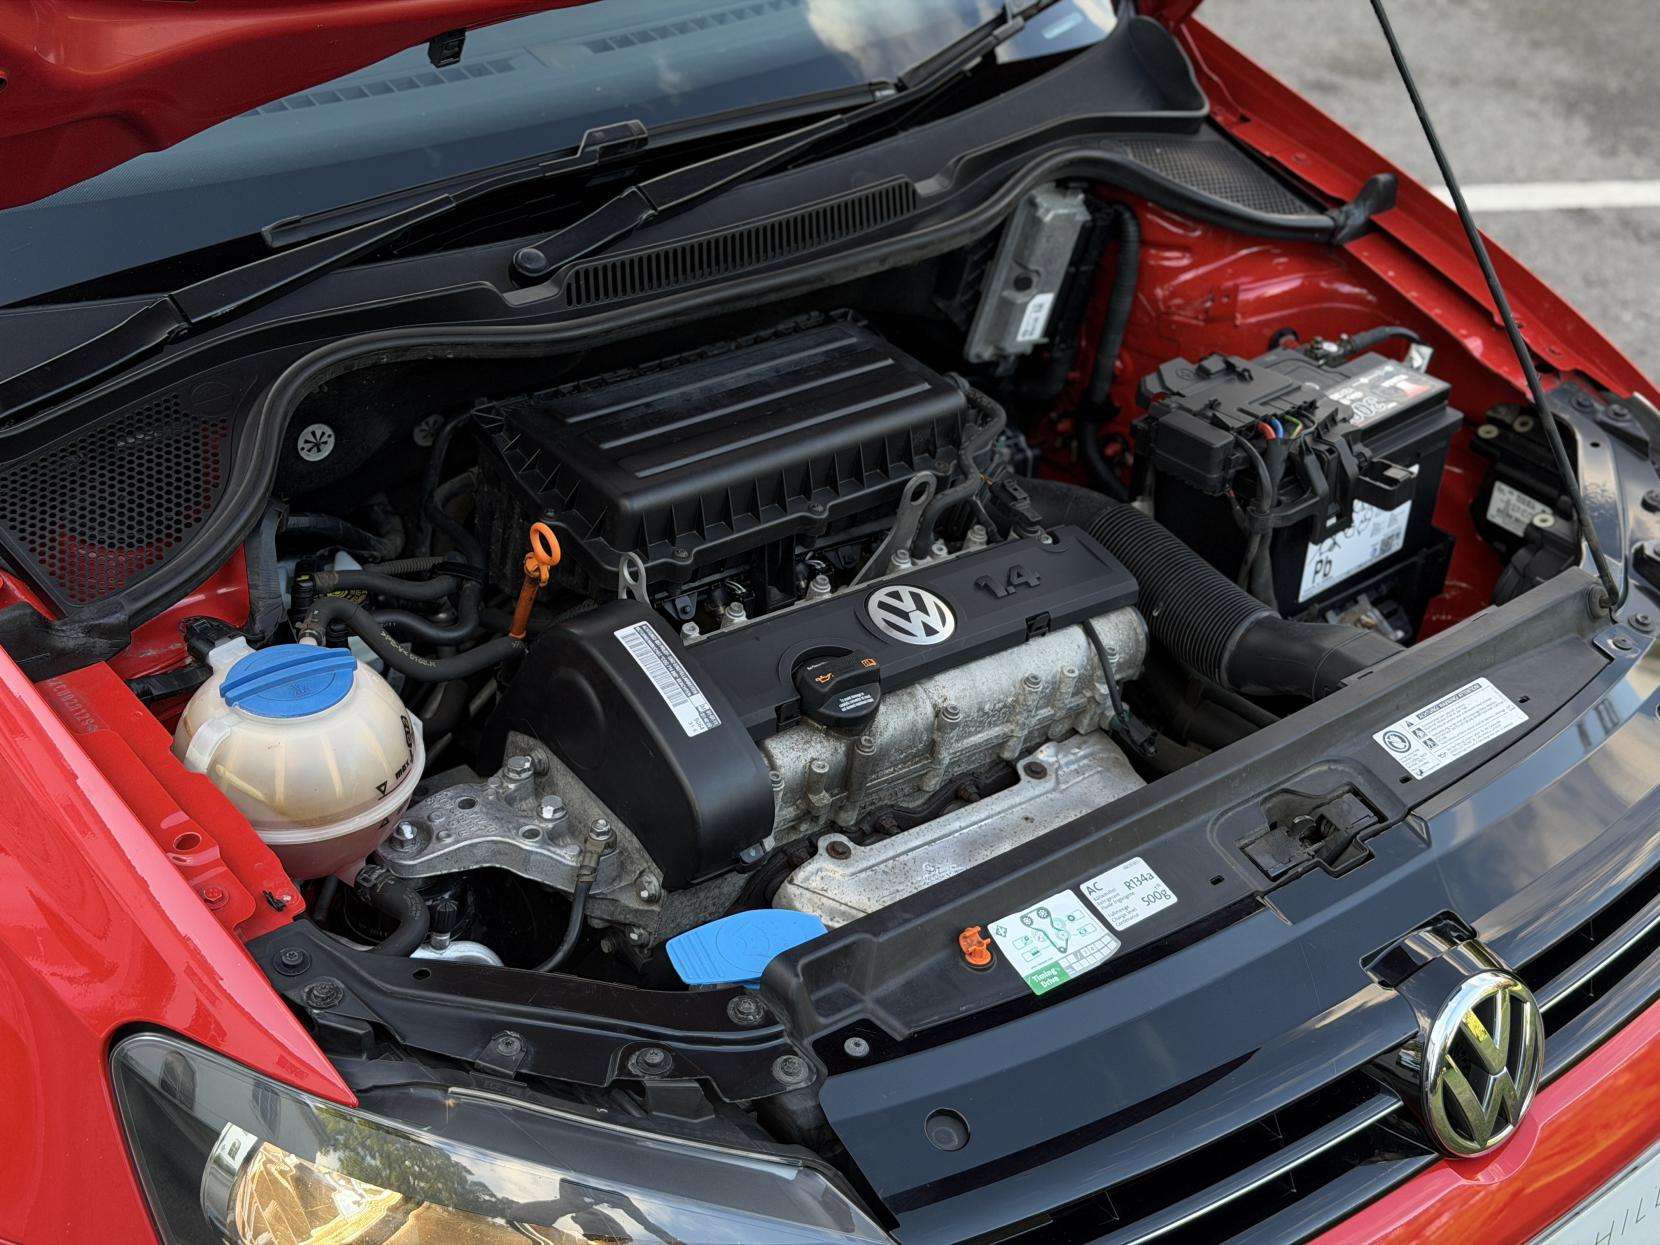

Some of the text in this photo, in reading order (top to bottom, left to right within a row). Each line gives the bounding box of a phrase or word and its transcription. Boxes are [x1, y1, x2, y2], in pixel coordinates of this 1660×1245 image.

[1312, 556, 1333, 584] Pb
[974, 564, 1041, 599] 1.4
[867, 585, 956, 645] VW
[395, 759, 410, 779] max
[1086, 881, 1103, 896] AC
[1123, 872, 1154, 890] R134a
[1141, 889, 1171, 906] 500g
[1032, 968, 1058, 982] Timing
[1041, 975, 1059, 988] Drive
[1430, 975, 1544, 1154] VW
